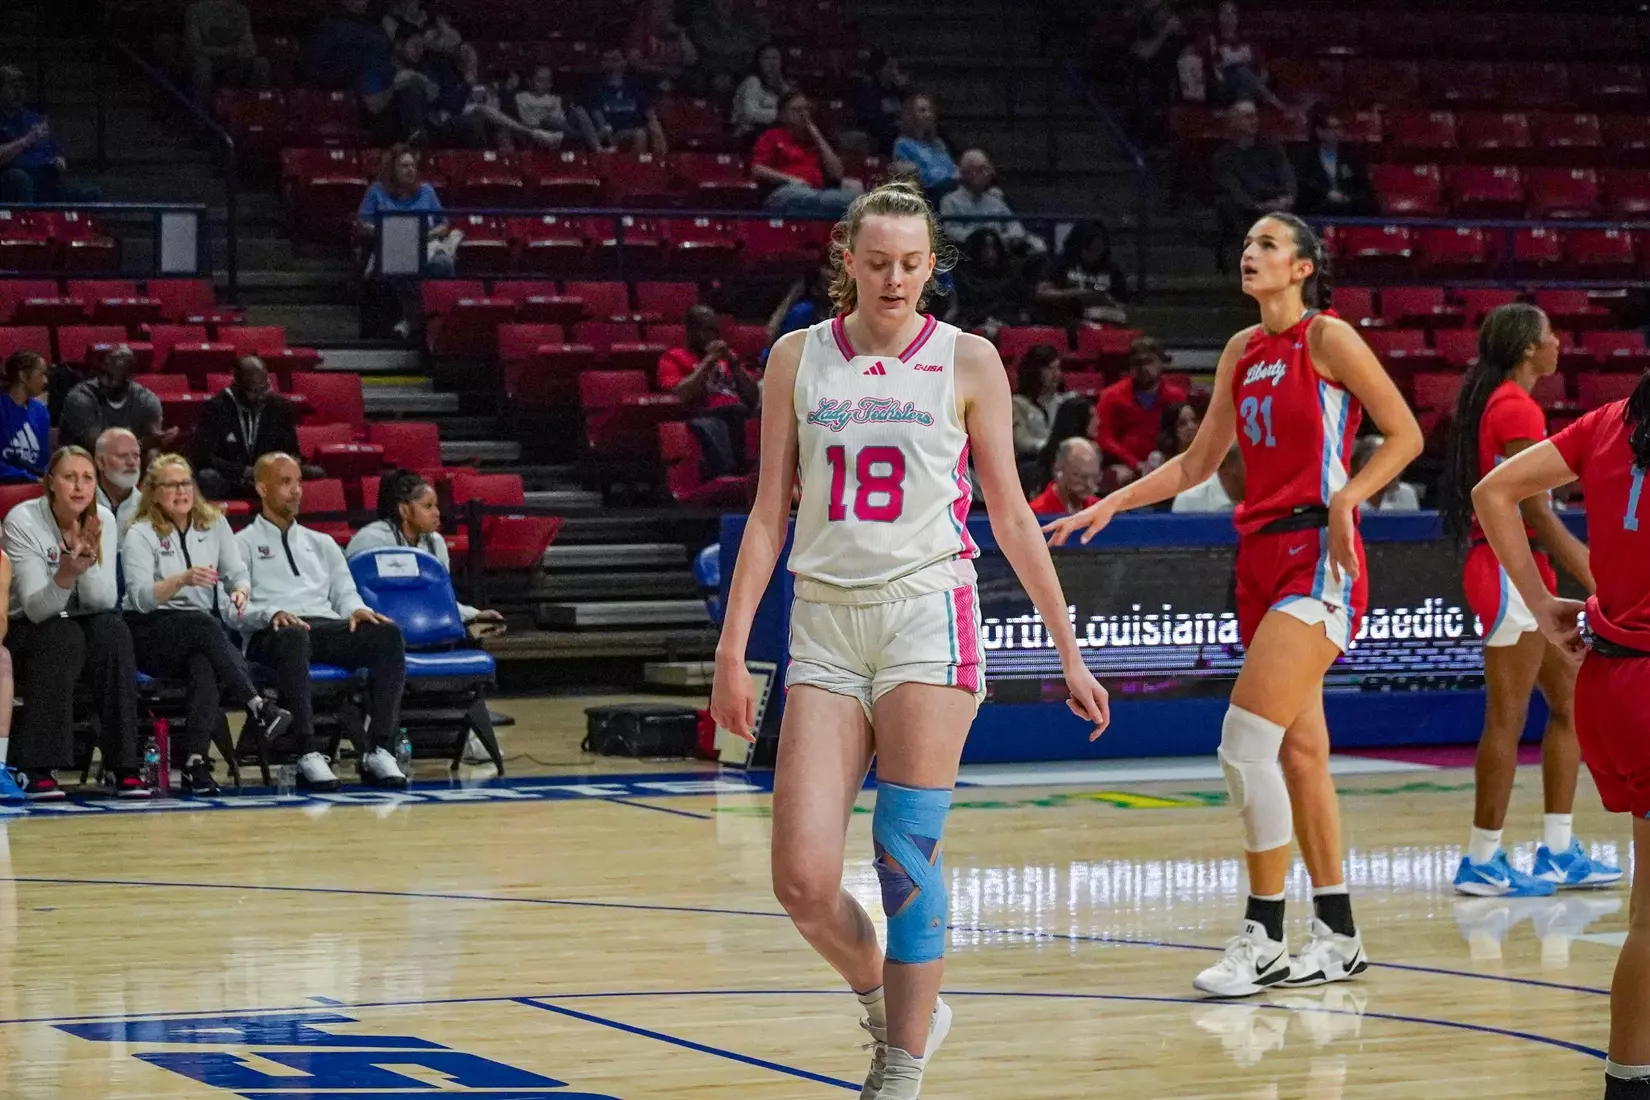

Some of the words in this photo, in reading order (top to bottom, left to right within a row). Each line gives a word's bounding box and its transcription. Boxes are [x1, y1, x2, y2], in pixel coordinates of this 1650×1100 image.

[913, 363, 943, 372] C-USA
[1243, 358, 1287, 387] Liberty
[807, 398, 852, 432] Lady
[851, 396, 934, 426] Techsters
[1240, 396, 1276, 447] 31
[825, 445, 906, 523] 18
